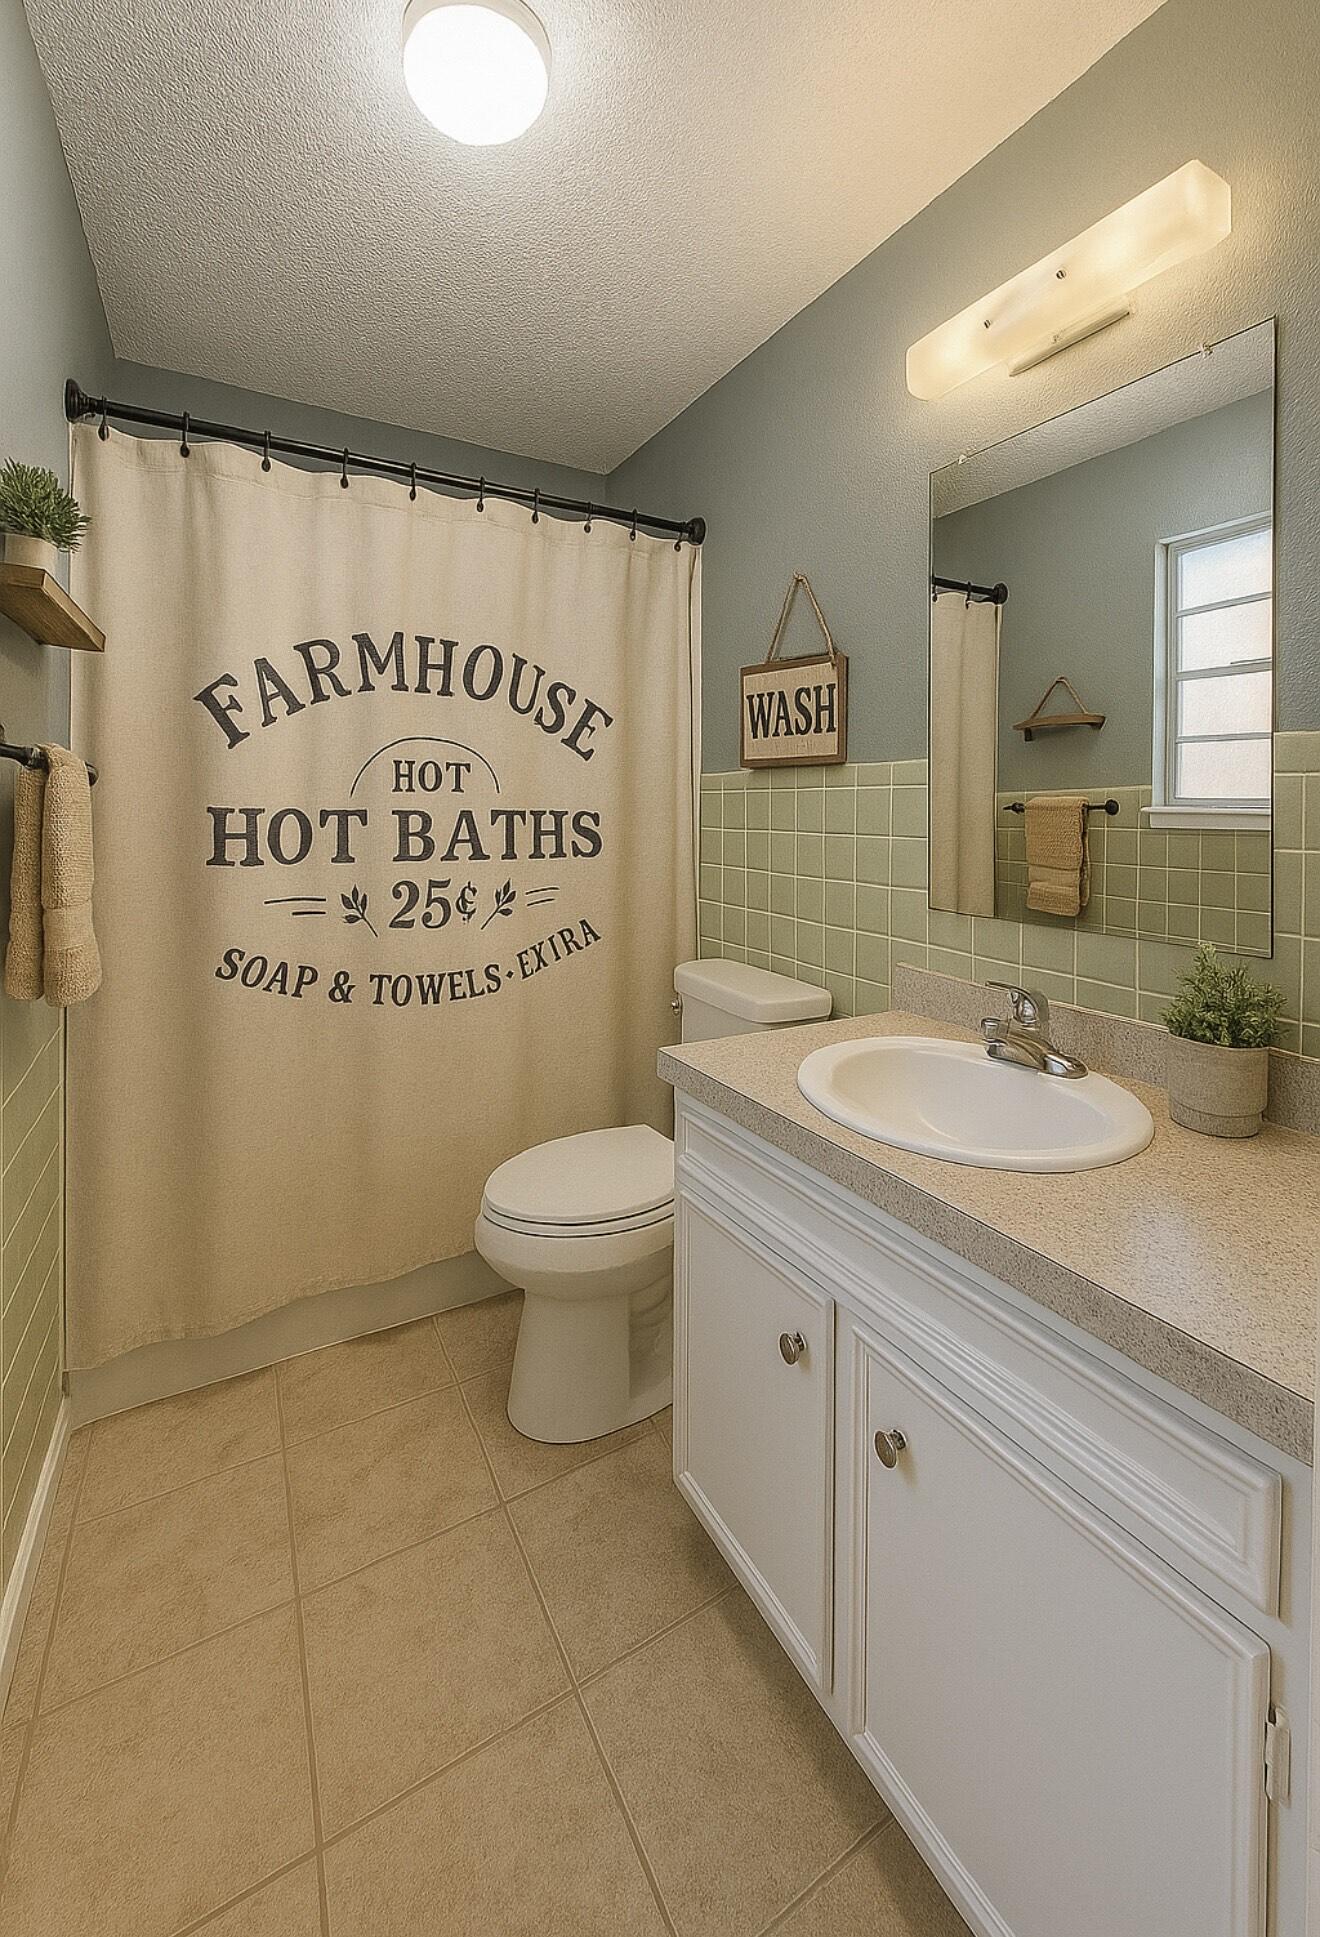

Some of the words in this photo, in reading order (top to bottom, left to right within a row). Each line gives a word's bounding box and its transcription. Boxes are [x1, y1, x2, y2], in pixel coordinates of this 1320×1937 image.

[193, 631, 614, 762] FARMHOUSE
[745, 682, 837, 740] WASH
[391, 759, 472, 794] HOT
[206, 806, 368, 867] HOT
[391, 808, 604, 864] BATHS
[388, 878, 478, 930] 25¢
[214, 948, 319, 999] SOAP
[328, 970, 357, 1005] &
[369, 963, 502, 1008] TOWELS
